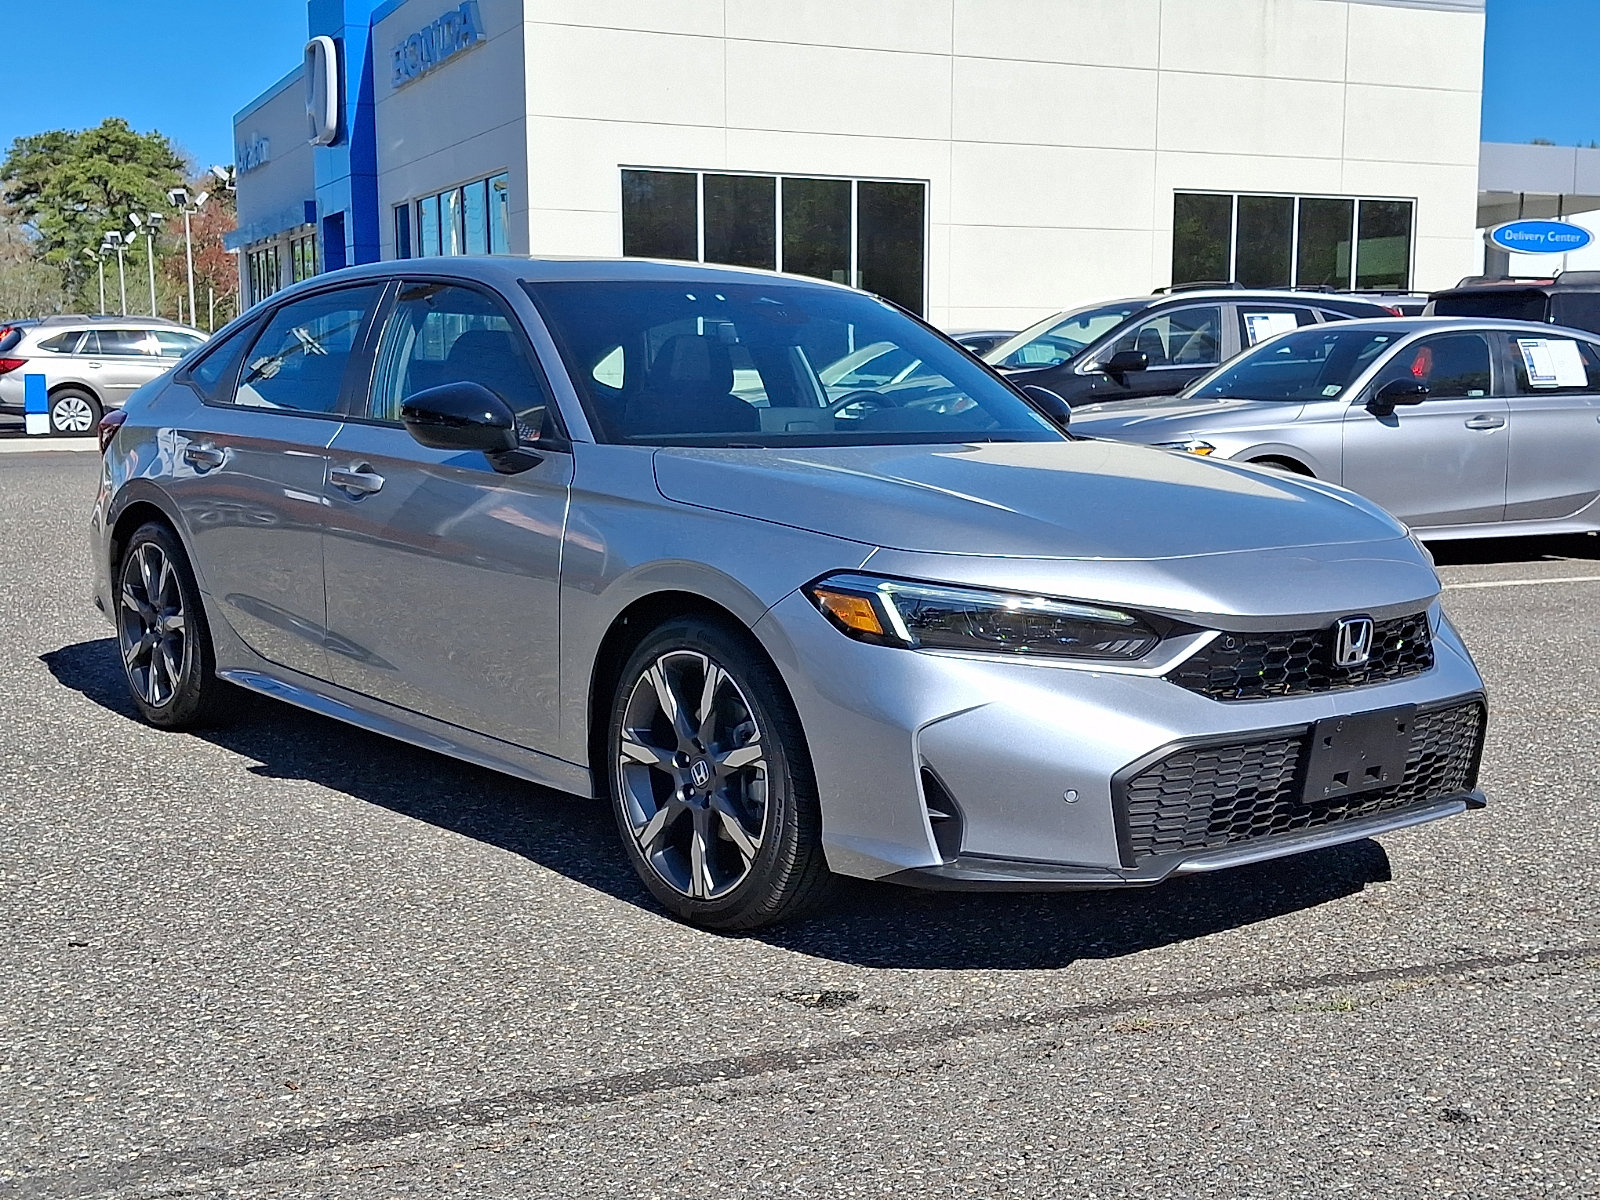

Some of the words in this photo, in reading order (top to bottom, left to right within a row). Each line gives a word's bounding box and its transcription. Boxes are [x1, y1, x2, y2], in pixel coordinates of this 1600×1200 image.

[390, 0, 485, 88] HONDA
[1504, 229, 1546, 245] Delivery
[1547, 231, 1582, 243] Center
